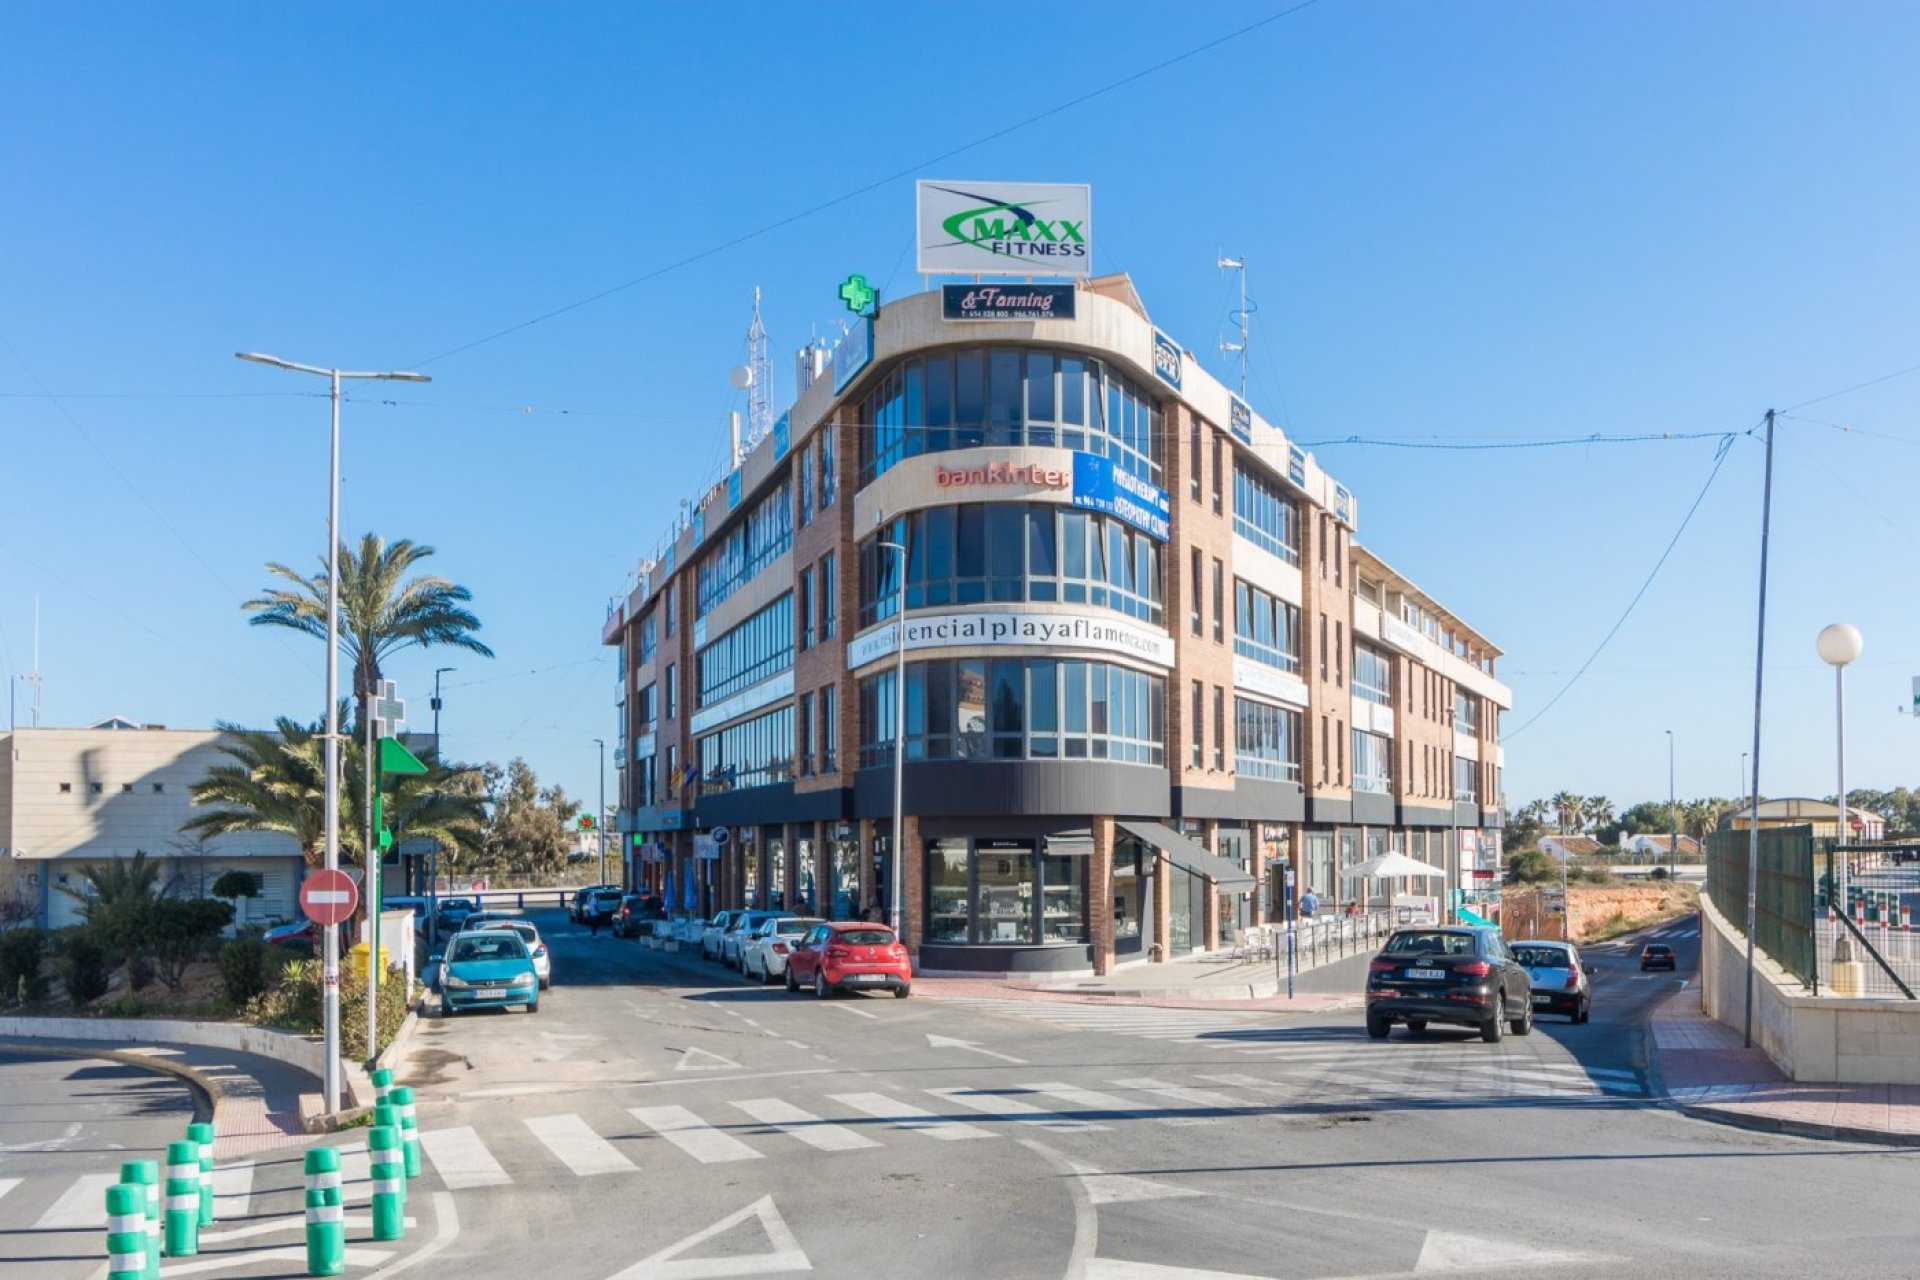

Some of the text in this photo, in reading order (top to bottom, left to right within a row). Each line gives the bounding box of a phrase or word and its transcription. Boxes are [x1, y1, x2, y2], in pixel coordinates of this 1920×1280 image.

[974, 218, 1085, 242] MAXX
[992, 242, 1086, 256] FITNESS
[979, 288, 1053, 310] Tanning
[935, 461, 1070, 487] bankinter
